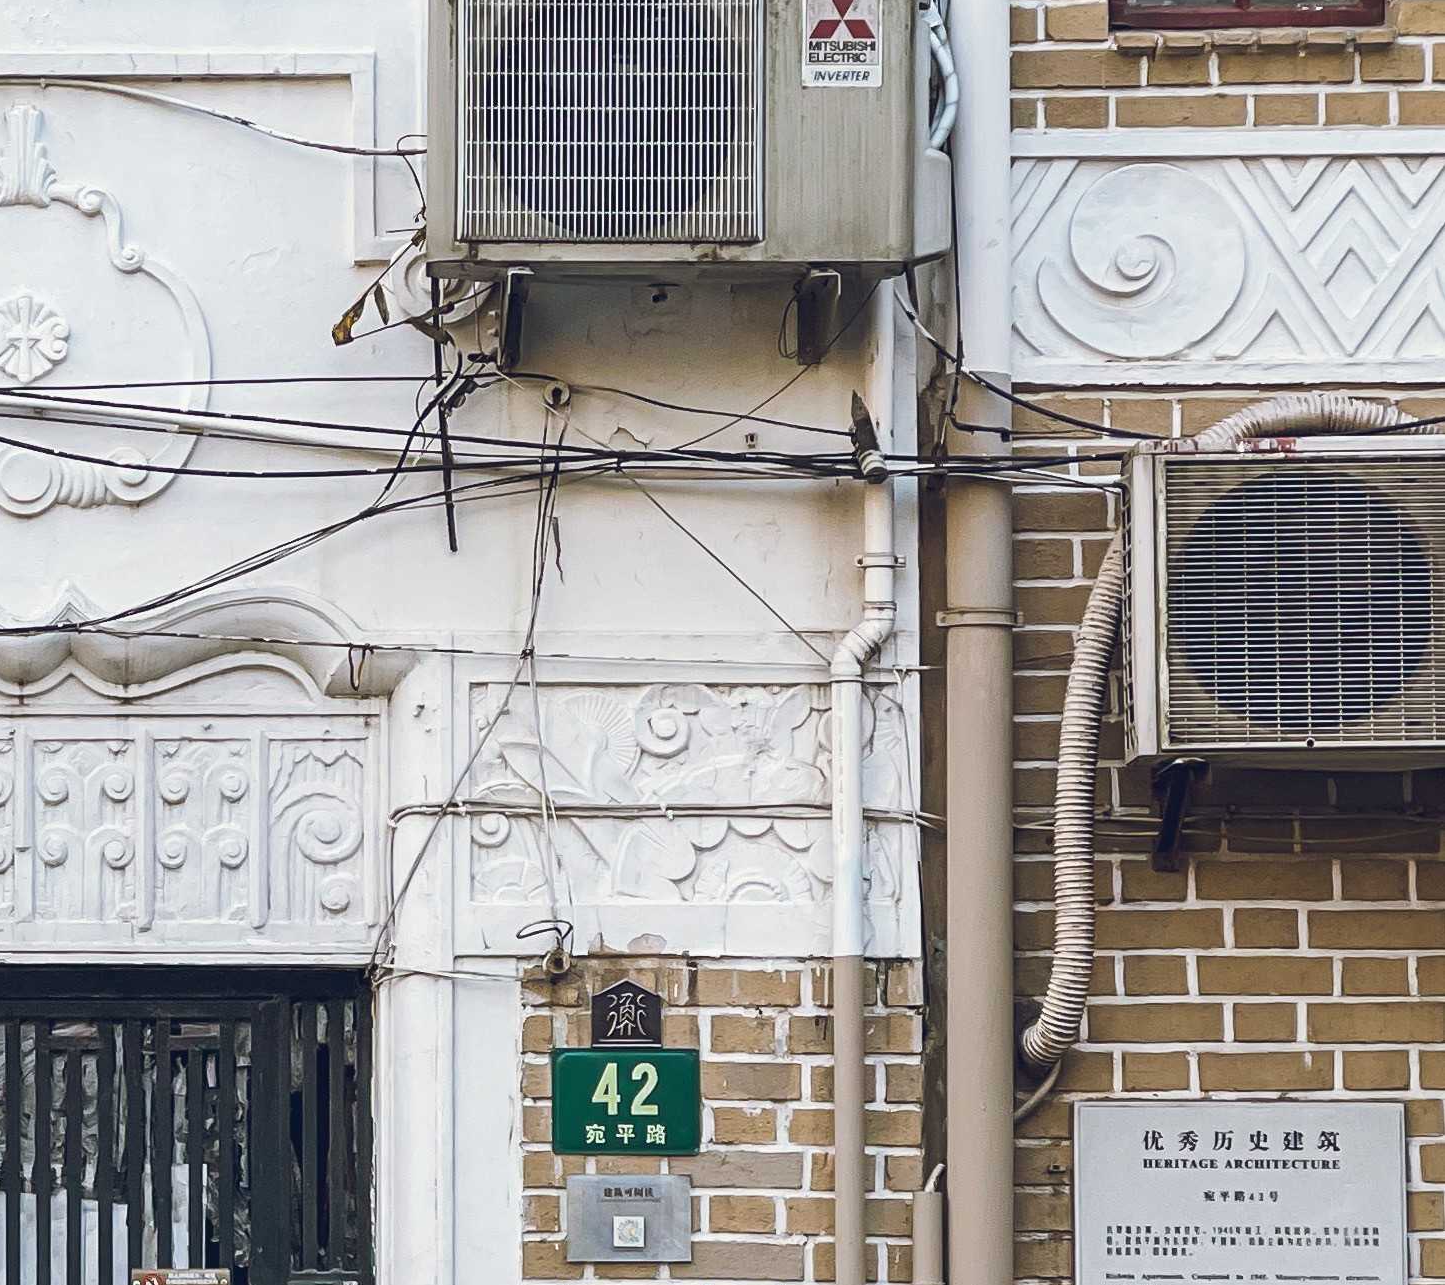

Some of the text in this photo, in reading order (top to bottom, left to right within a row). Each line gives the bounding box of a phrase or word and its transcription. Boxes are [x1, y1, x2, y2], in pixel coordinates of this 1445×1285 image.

[808, 41, 876, 51] MITSUBISHI
[808, 53, 867, 63] ELECTRIC
[813, 70, 871, 82] INVERTER
[591, 1062, 659, 1116] 42
[585, 1124, 667, 1145] 宛平路
[1142, 1130, 1341, 1152] 优秀历史建筑
[1143, 1159, 1341, 1170] HERITAGE ARCHITECTURE
